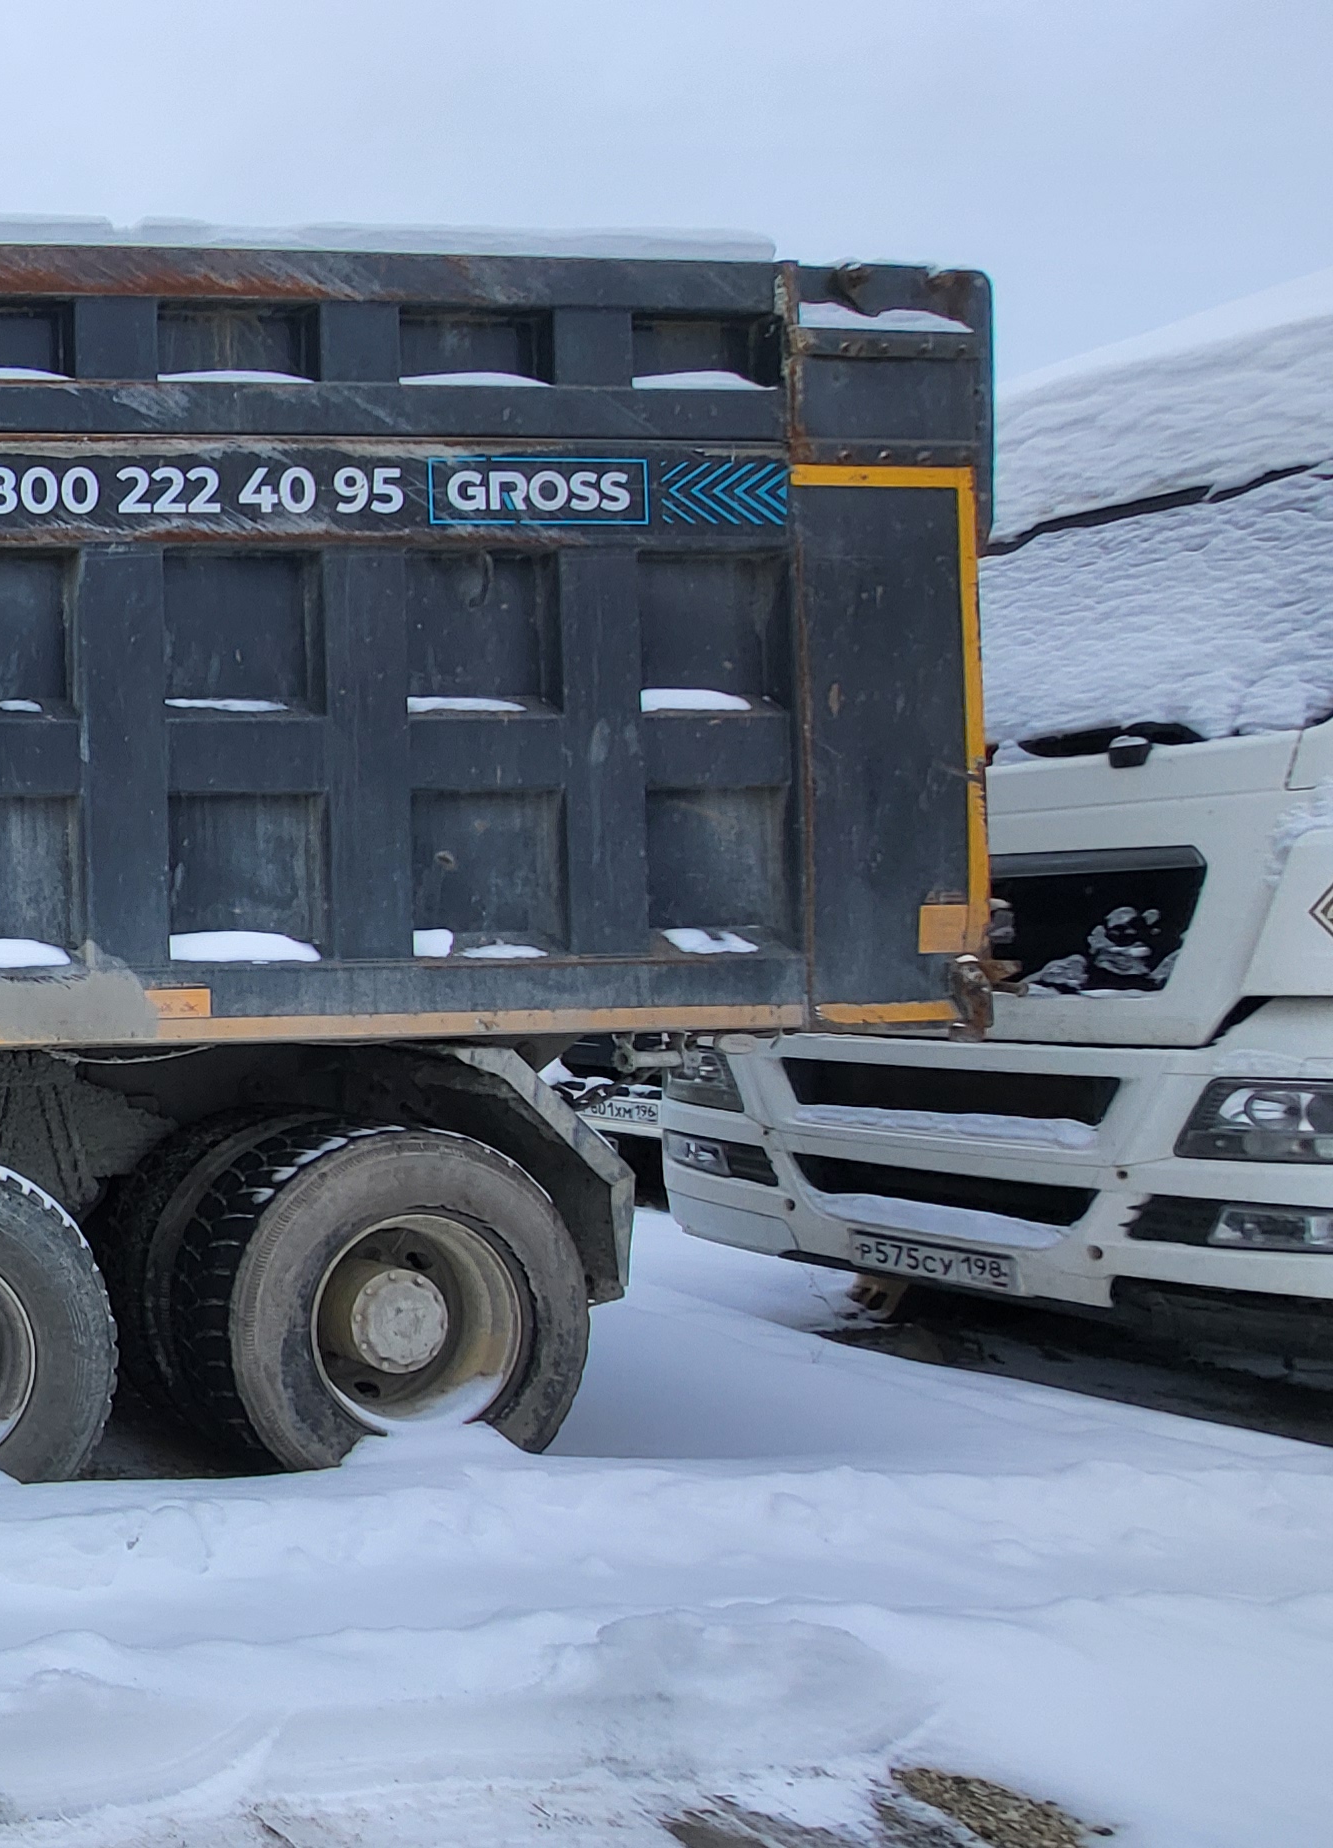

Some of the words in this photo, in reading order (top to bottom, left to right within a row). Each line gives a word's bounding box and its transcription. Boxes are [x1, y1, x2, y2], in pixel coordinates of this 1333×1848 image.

[116, 467, 221, 514] 222
[238, 467, 316, 514] 40
[333, 467, 404, 514] 95
[446, 470, 631, 513] GROSS
[961, 1256, 1001, 1278] 198
